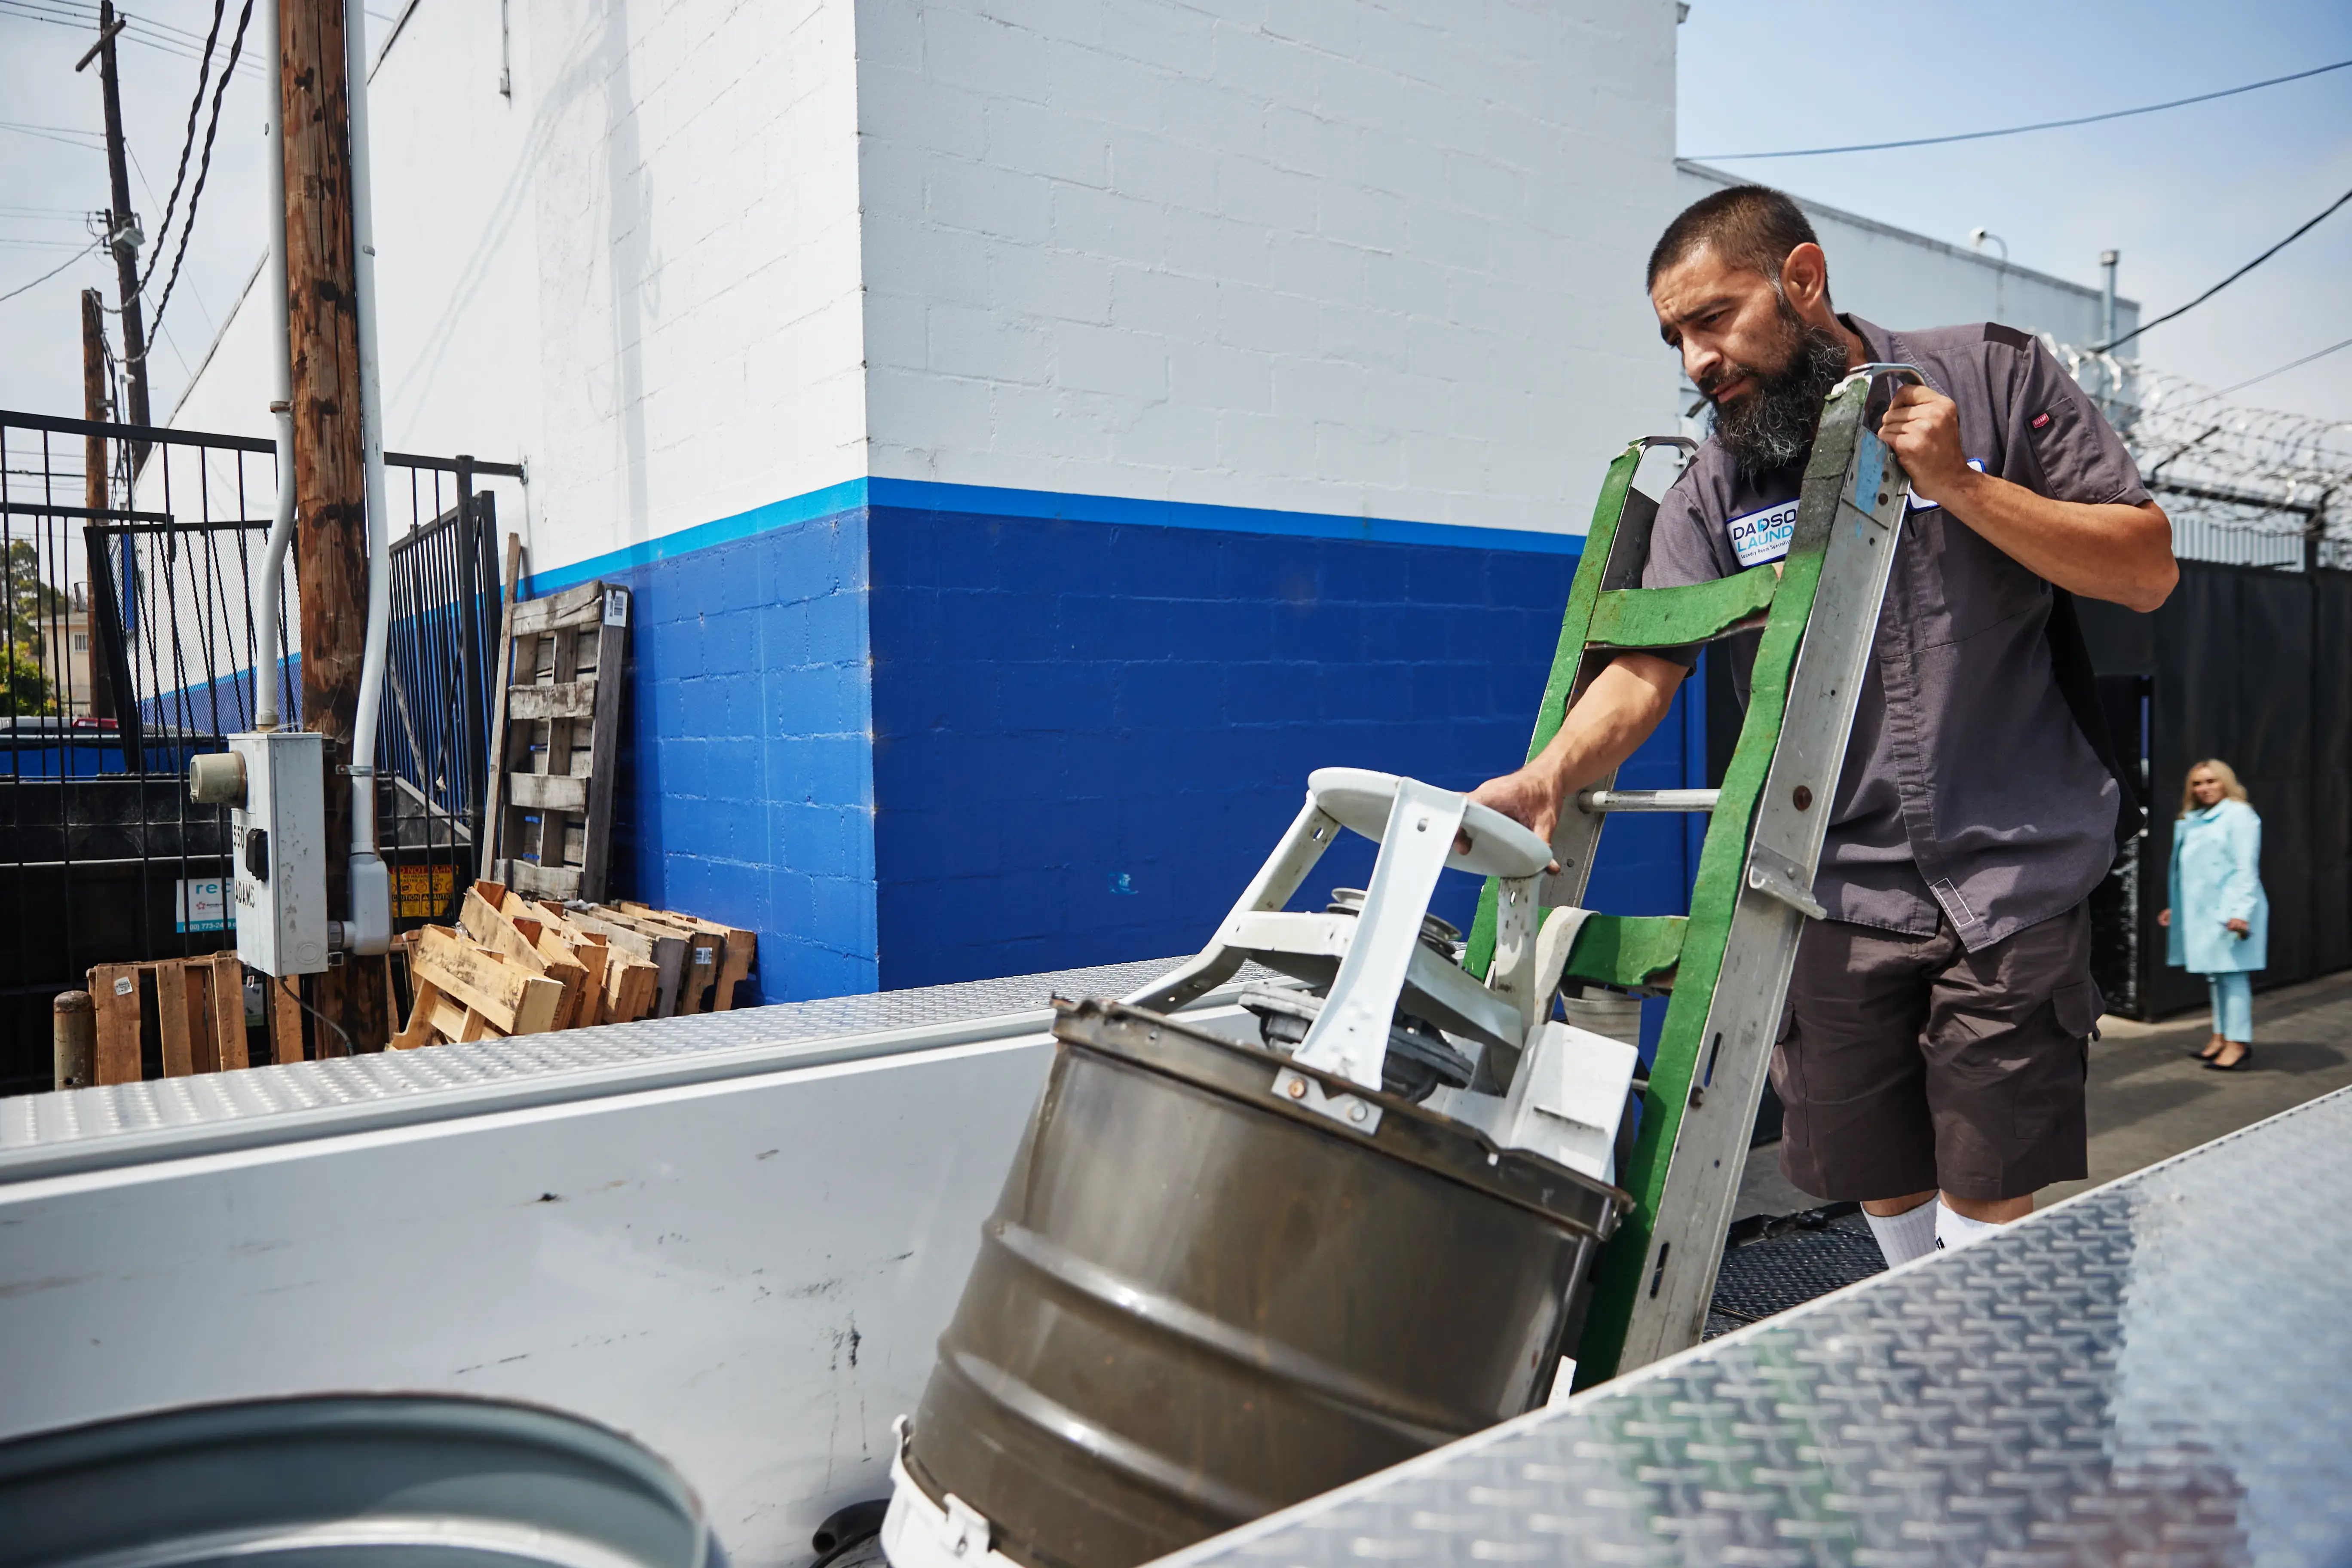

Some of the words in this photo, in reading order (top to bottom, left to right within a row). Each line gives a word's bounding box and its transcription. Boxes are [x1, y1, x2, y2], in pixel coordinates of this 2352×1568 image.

[1733, 509, 1797, 540] DADSO
[1737, 525, 1793, 552] LAUND
[236, 880, 254, 908] ADAMS
